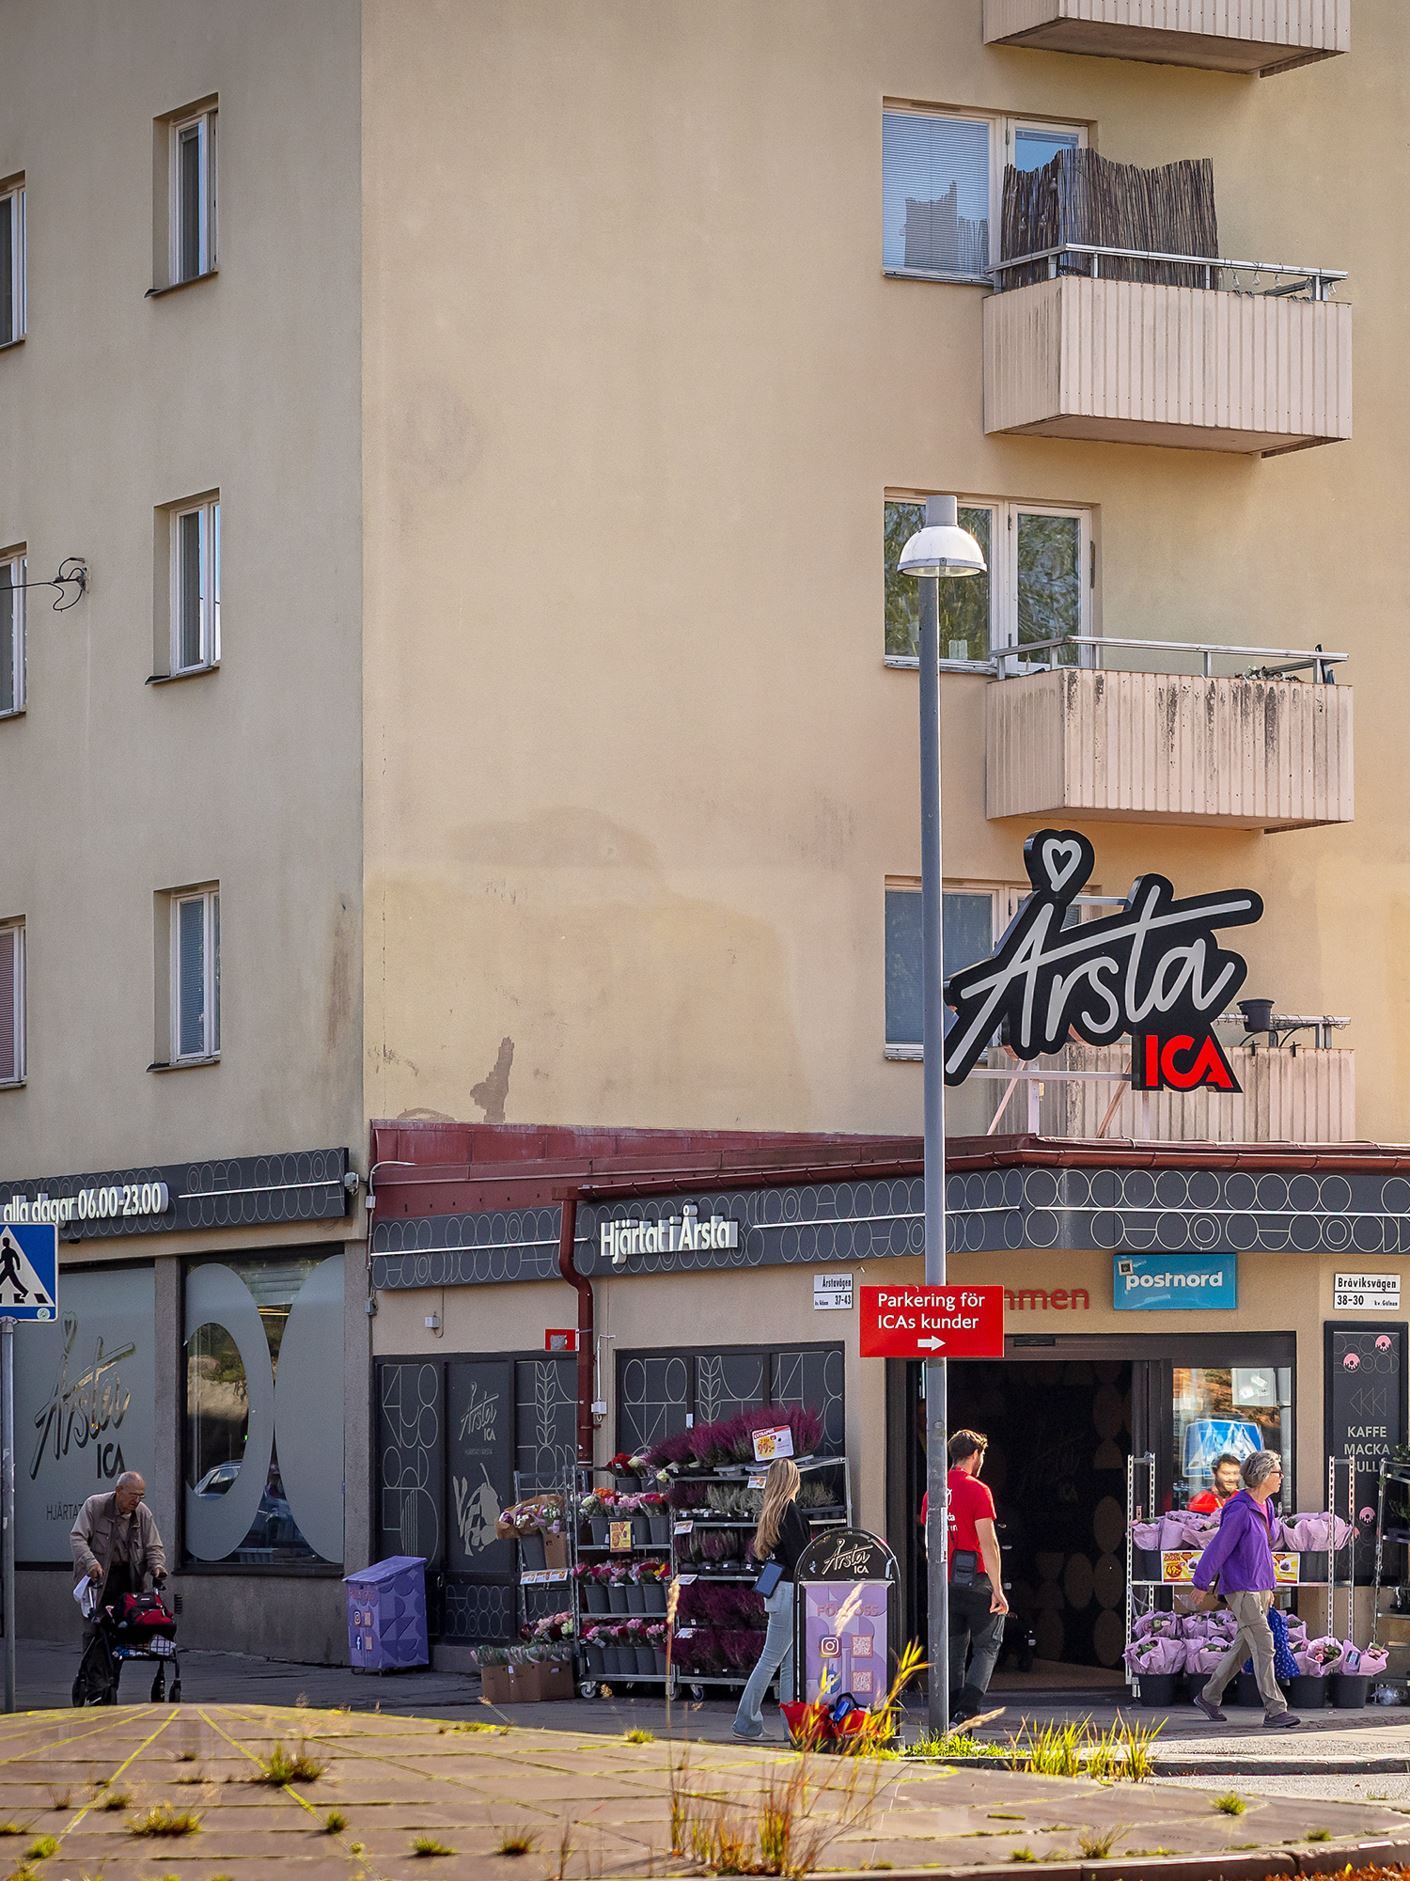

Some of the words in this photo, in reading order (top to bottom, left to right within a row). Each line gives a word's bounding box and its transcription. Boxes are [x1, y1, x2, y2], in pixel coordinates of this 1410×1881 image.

[944, 837, 1252, 1074] Årsta
[1145, 1034, 1234, 1089] ICA
[3, 1195, 29, 1222] alla
[32, 1193, 76, 1224] dagar
[78, 1182, 162, 1220] 06.00-23.00
[600, 1219, 665, 1264] Hjärtat
[678, 1204, 732, 1251] Årsta
[1125, 1271, 1223, 1291] postnord
[1337, 1276, 1397, 1291] Bråviksvägen
[835, 1294, 851, 1305] 37-43
[877, 1291, 956, 1311] Parkering
[960, 1291, 986, 1308] för
[1336, 1295, 1364, 1306] 38-30
[877, 1315, 916, 1329] ICAs
[921, 1313, 979, 1330] kunder
[29, 1311, 136, 1480] Årsta
[483, 1427, 497, 1441] ICA
[1347, 1425, 1387, 1438] KAFFE
[1344, 1443, 1391, 1455] MACKA
[96, 1443, 126, 1479] ICA
[1355, 1460, 1381, 1473] ULL
[821, 1538, 874, 1576] Årsta
[853, 1564, 870, 1575] ICA
